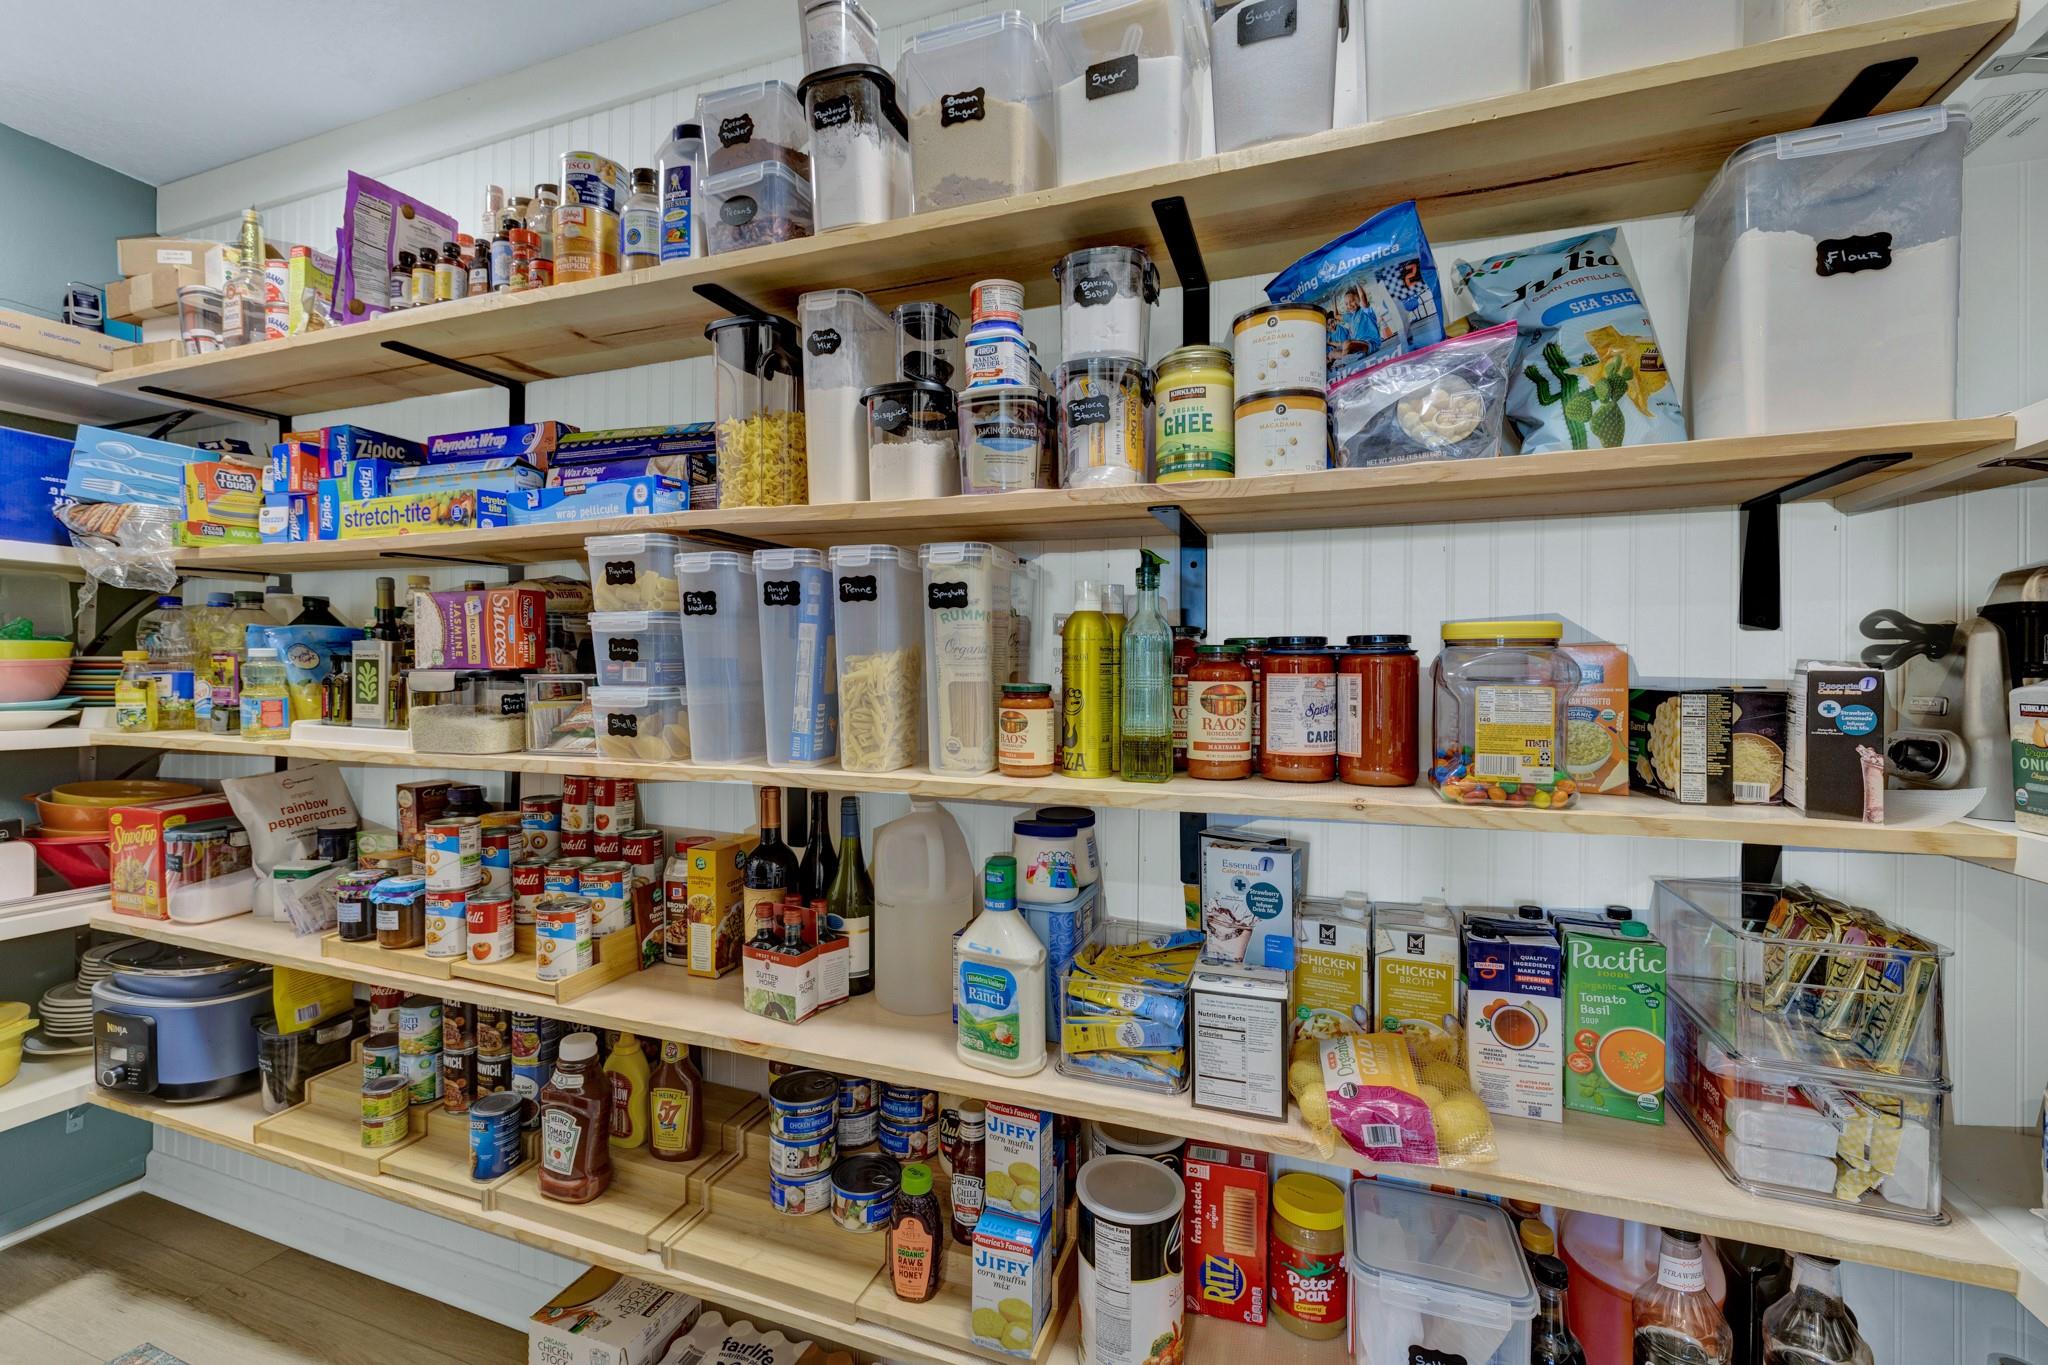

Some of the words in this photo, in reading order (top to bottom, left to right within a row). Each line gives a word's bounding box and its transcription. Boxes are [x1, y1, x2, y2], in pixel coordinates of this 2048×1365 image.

[1245, 5, 1284, 25] Sugar
[1092, 67, 1127, 86] Sugar
[945, 95, 978, 107] Brown
[814, 104, 848, 120] Powdered
[948, 106, 979, 118] Sugar
[822, 112, 848, 127] Sugar
[722, 126, 751, 140] Powder
[1337, 242, 1400, 274] America
[1565, 272, 1610, 288] TORTILLA
[1280, 278, 1320, 304] Scouting
[1569, 299, 1600, 314] SEA
[1601, 292, 1637, 306] SALT
[812, 333, 839, 342] Pancake
[1252, 333, 1296, 344] MACADAMIA
[817, 342, 832, 350] Mix
[972, 361, 1001, 369] POWDER
[1170, 388, 1205, 396] KIRKLAND
[1069, 402, 1104, 412] Tapioca
[1172, 405, 1205, 415] ORGANIC
[873, 407, 908, 424] Bisquick
[1074, 411, 1105, 420] Starch
[1164, 413, 1214, 437] GHEE
[1259, 421, 1303, 430] MACADAMIA
[978, 428, 1003, 437] BAKING
[355, 438, 406, 460] Ziploc
[432, 437, 478, 454] Reynolds
[478, 433, 508, 450] Wrap
[336, 434, 349, 468] Ziploc
[272, 457, 283, 482] Ziploc
[564, 468, 581, 477] Wax
[581, 466, 607, 476] Paper
[218, 471, 252, 484] TEXAS
[217, 479, 254, 492] TOUGH
[321, 494, 333, 531] Ziploc
[344, 502, 432, 529] stretch-tite
[555, 510, 577, 519] wrap
[579, 503, 620, 517] pellicule
[290, 508, 302, 541] Ziploc
[231, 530, 253, 538] WAX
[768, 584, 790, 594] Angel
[842, 583, 872, 594] Penne
[687, 594, 703, 604] Egg
[453, 603, 464, 658] JASMINE
[492, 593, 509, 666] Success
[1583, 697, 1611, 706] RISOTTO
[1304, 702, 1330, 720] Spicy
[612, 719, 637, 731] Shells
[1202, 717, 1246, 731] RAO'S
[1001, 733, 1028, 744] RAO'S
[280, 798, 329, 816] rainbow
[268, 806, 347, 833] peppercorns
[111, 826, 140, 854] Stove
[139, 824, 157, 846] Top
[1222, 859, 1260, 870] Essential
[1249, 888, 1280, 898] Strawberry
[1250, 895, 1279, 903] Lemonade
[1300, 953, 1356, 971] CHICKEN
[1568, 940, 1666, 973] Pacific
[1312, 966, 1345, 978] BROTH
[1386, 962, 1447, 980] CHICKEN
[1513, 961, 1556, 970] INGREDIENTS
[755, 970, 780, 981] SUTTER
[967, 973, 988, 985] Hidden
[987, 976, 1008, 991] Valley
[1399, 976, 1435, 988] BROTH
[1517, 976, 1551, 984] SUPERIOR
[758, 978, 777, 988] HOME
[799, 977, 816, 991] SUTTER
[800, 983, 815, 994] HOME
[1521, 984, 1547, 992] FLAVOR
[968, 986, 1006, 1006] Ranch
[1579, 992, 1627, 1005] Tomato
[1198, 1010, 1229, 1021] Nutrition
[1230, 1013, 1247, 1022] Facts
[1579, 1004, 1610, 1016] Basil
[1580, 1016, 1600, 1025] SOUP
[106, 1022, 128, 1036] NINJA
[1198, 1029, 1224, 1039] Calories
[1240, 1032, 1246, 1042] 5
[1336, 1034, 1356, 1078] Organics
[1357, 1038, 1379, 1077] GOLD
[1478, 1051, 1508, 1059] HOMEMADE
[658, 1092, 679, 1101] HEINZ
[899, 1105, 918, 1113] BREAST
[986, 1101, 1014, 1115] America's
[1013, 1109, 1038, 1121] Favorite
[550, 1115, 569, 1127] HEINZ
[789, 1120, 811, 1129] CHICKEN
[811, 1116, 829, 1126] BREAST
[547, 1126, 573, 1139] TOMATO
[987, 1116, 1037, 1142] JIFFY
[547, 1133, 571, 1145] KETCHUP
[989, 1133, 1006, 1143] corn
[1007, 1139, 1034, 1151] muffin
[1003, 1146, 1020, 1155] mix
[956, 1177, 978, 1188] HEINZ
[957, 1186, 977, 1197] CHILI
[1190, 1181, 1202, 1213] stacks
[956, 1195, 979, 1206] SAUCE
[1115, 1226, 1131, 1236] Facts
[1190, 1214, 1202, 1244] fresh
[974, 1234, 1005, 1248] America's
[1005, 1241, 1031, 1255] Favorite
[898, 1249, 925, 1258] ORGANIC
[898, 1258, 915, 1267] RAW
[916, 1258, 923, 1267] &
[975, 1251, 1030, 1277] JIFFY
[898, 1270, 923, 1279] HONEY
[977, 1268, 996, 1279] corn
[997, 1274, 1027, 1287] muffin
[1203, 1254, 1235, 1305] RITZ
[1287, 1270, 1335, 1292] Peter
[993, 1281, 1011, 1291] mix
[1293, 1287, 1330, 1303] Pan
[1295, 1304, 1322, 1312] Creamy
[543, 1336, 568, 1348] ORGANIC
[537, 1341, 574, 1361] CHICKEN
[721, 1336, 775, 1364] fairlife
[540, 1351, 569, 1365] STOCK
[718, 1352, 748, 1363] nutrition
